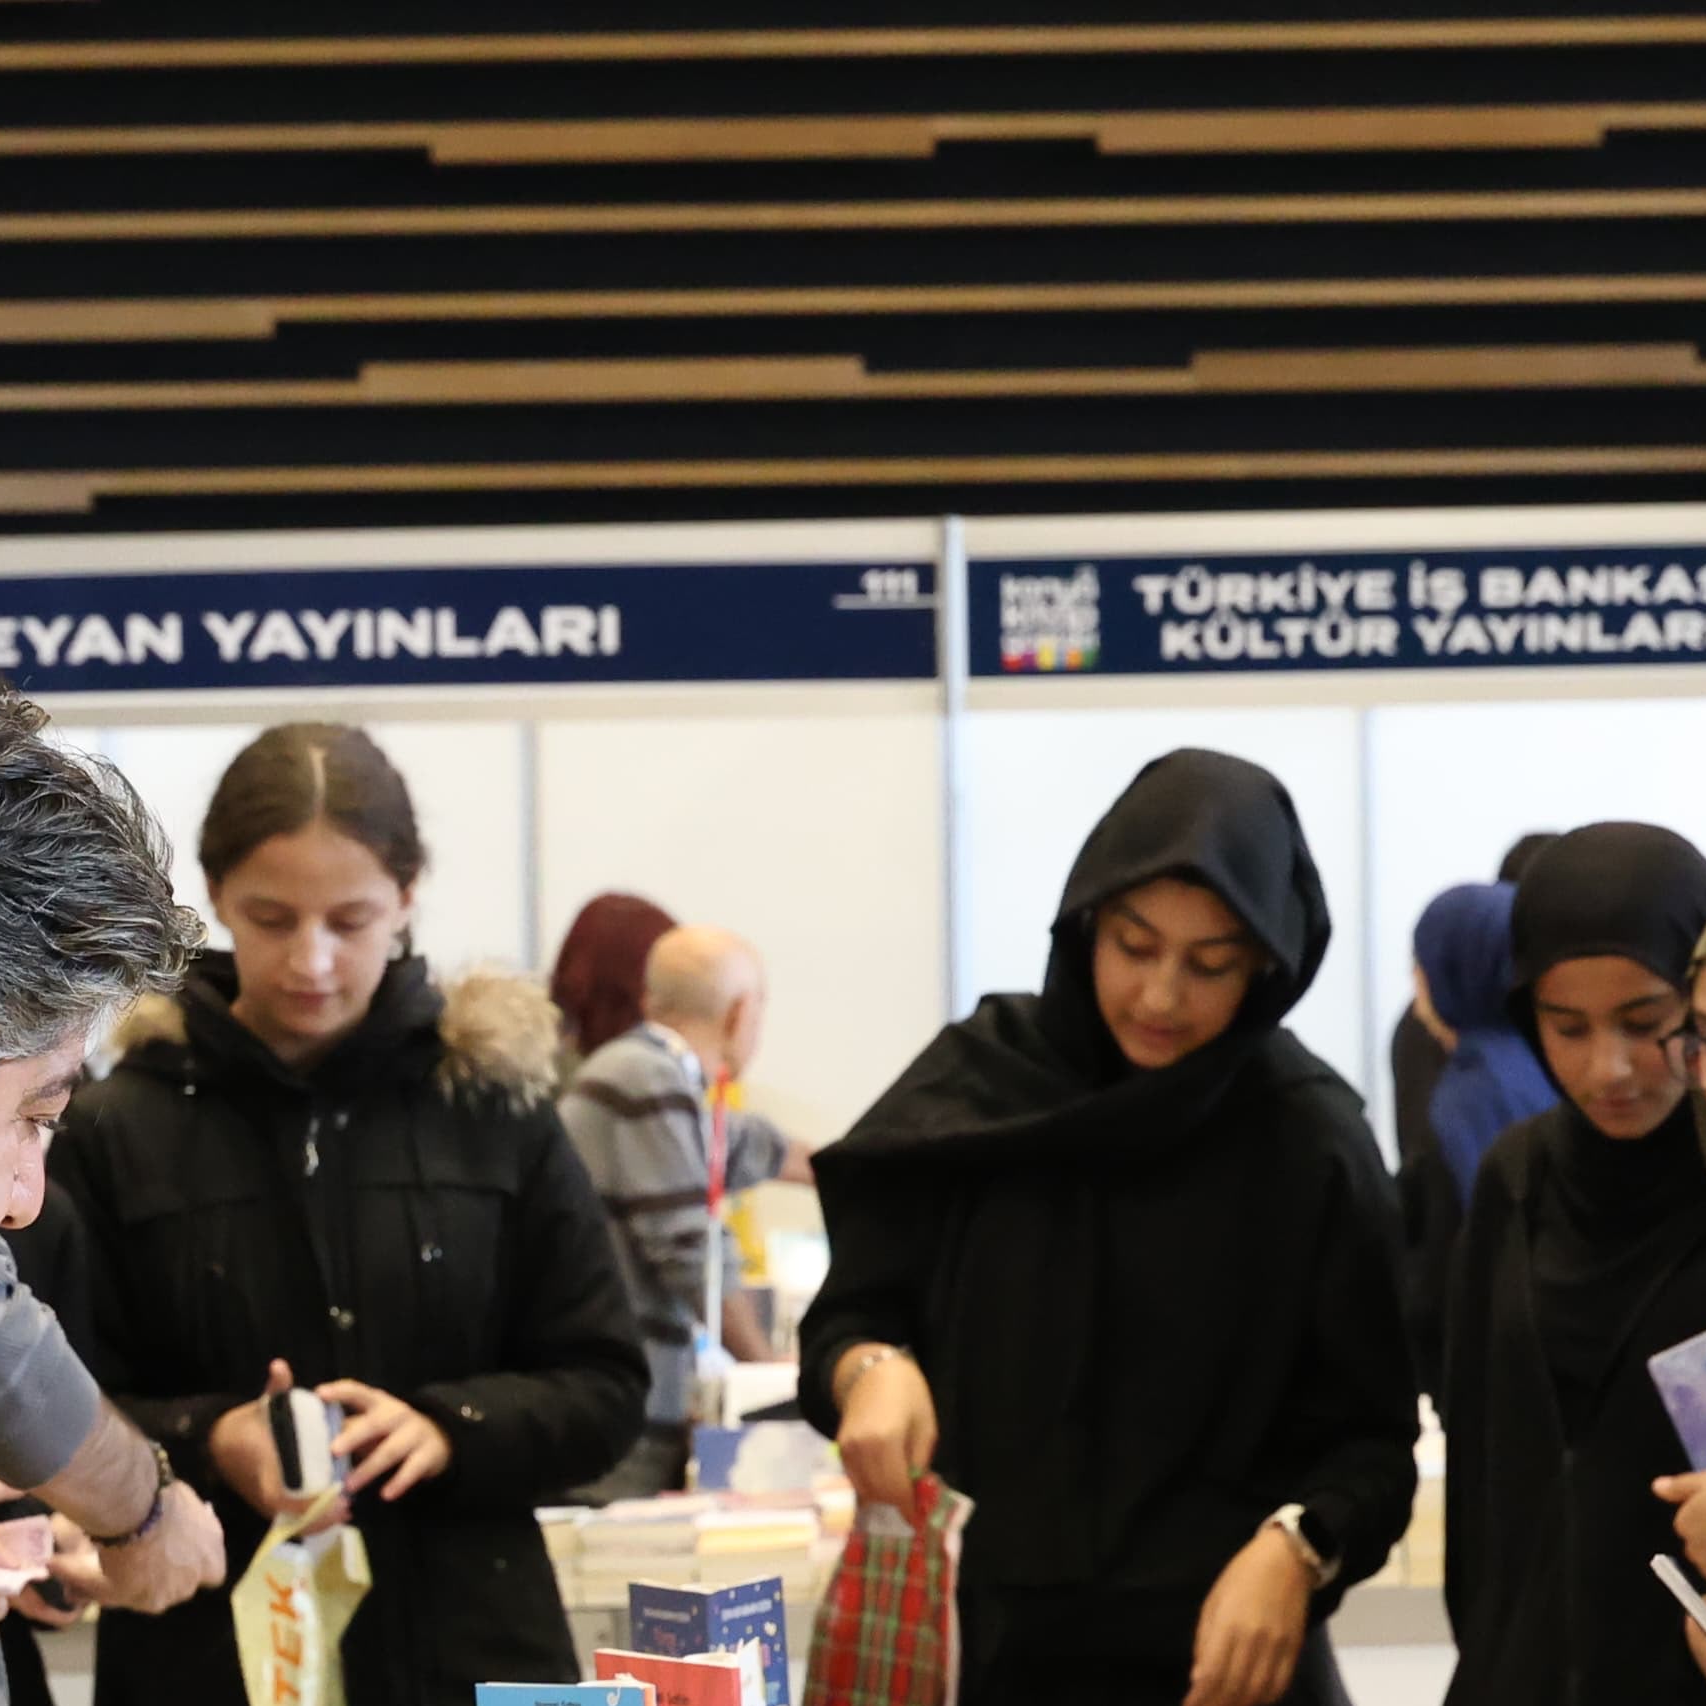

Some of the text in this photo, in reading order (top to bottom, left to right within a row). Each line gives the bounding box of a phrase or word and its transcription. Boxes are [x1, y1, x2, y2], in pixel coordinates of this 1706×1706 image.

[1132, 563, 1395, 614] TÜRKİYE
[1409, 560, 1453, 620] İŞ
[201, 604, 623, 662] YAYINLARI
[1160, 606, 1398, 660] KÜLTÜR
